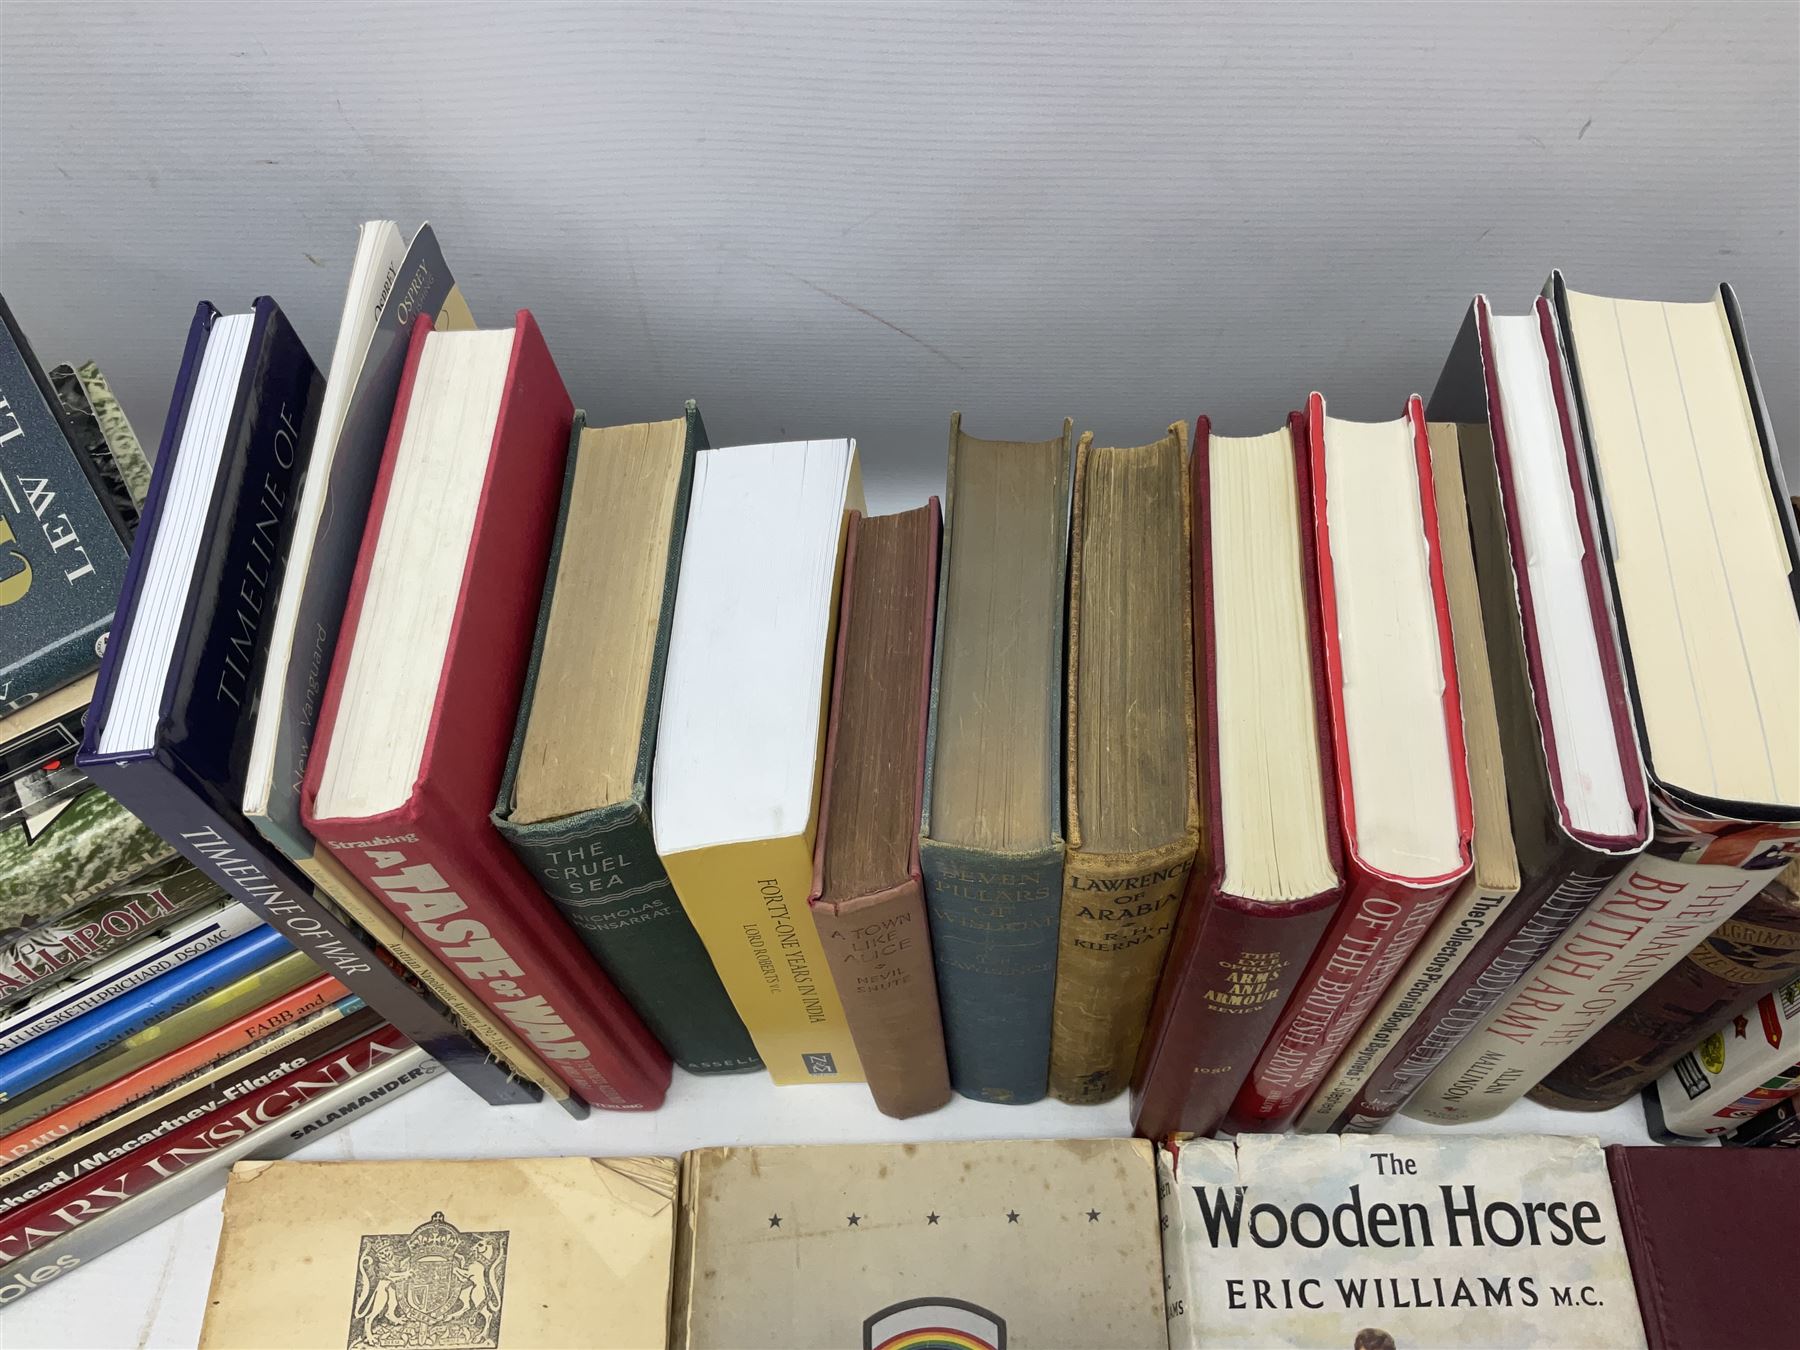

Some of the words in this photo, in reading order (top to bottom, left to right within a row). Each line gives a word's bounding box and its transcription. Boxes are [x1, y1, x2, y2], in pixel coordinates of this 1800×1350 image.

[398, 258, 428, 324] OSPREY
[16, 475, 96, 586] LEW
[217, 473, 286, 706] TIMELINE
[274, 402, 298, 470] OF
[300, 622, 327, 726] Vanguard
[328, 832, 420, 850] Straubing
[546, 841, 605, 865] THE
[364, 850, 407, 869] A
[543, 854, 632, 881] CRUEL
[1070, 858, 1194, 893] LAWRENCE
[61, 865, 143, 908] James
[570, 874, 624, 894] SEA
[935, 879, 1051, 903] PILLARS
[942, 868, 1041, 886] SEVEN
[180, 825, 306, 916] TIMELINE
[286, 917, 334, 941] OF
[310, 940, 371, 977] WAR
[758, 878, 801, 949] FORTY-ONE
[1076, 893, 1177, 921] ARABIA
[1113, 890, 1146, 905] OF
[1355, 897, 1402, 931] OF
[1467, 895, 1506, 921] The
[1503, 871, 1614, 958] MILITARY
[1674, 879, 1750, 919] THE
[371, 863, 526, 980] TASTE
[743, 923, 765, 951] LORD
[831, 929, 846, 941] A
[850, 911, 912, 940] TOWN
[1073, 922, 1170, 953] KIERNAN
[1543, 870, 1690, 981] BRITISH
[843, 937, 913, 963] ALICE
[851, 929, 897, 952] LIKE
[1241, 951, 1281, 961] THE
[1324, 932, 1384, 978] THE
[1428, 916, 1485, 974] Collectors
[386, 943, 422, 970] Austrian
[417, 968, 457, 1003] Napoleonic
[753, 948, 780, 985] ROBERTS
[785, 950, 813, 984] YEARS
[857, 967, 905, 985] NEVIL
[1598, 924, 1700, 994] MAKING
[798, 984, 818, 997] IN
[1225, 970, 1281, 984] ARMS
[1228, 982, 1268, 996] AND
[1399, 971, 1442, 1012] Pictorial
[802, 995, 826, 1025] INDIA
[1202, 988, 1280, 1007] ARMOUR
[1207, 1003, 1264, 1015] REVIEW
[1285, 975, 1354, 1048] BRITISH
[1484, 975, 1575, 1046] ARMY
[1575, 998, 1617, 1018] OF
[245, 1010, 294, 1040] FABB
[296, 993, 327, 1017] and
[493, 994, 591, 1060] WAR
[1539, 1019, 1596, 1047] THE
[260, 1036, 297, 1057] Velimir
[1260, 1043, 1309, 1089] ARMY
[1440, 1049, 1507, 1103] MALLINSON
[1483, 1067, 1525, 1094] ALLAN
[142, 1041, 402, 1180] INSIGNIA
[289, 1066, 424, 1141] SALAMANDER
[0, 1156, 55, 1187] 941-45
[1370, 1152, 1417, 1177] The
[1192, 1185, 1434, 1250] Wooden
[1440, 1184, 1607, 1249] Horse
[1226, 1278, 1323, 1311] ERIC
[1335, 1276, 1540, 1310] WILLIAMS
[1553, 1285, 1605, 1308] M.C.
